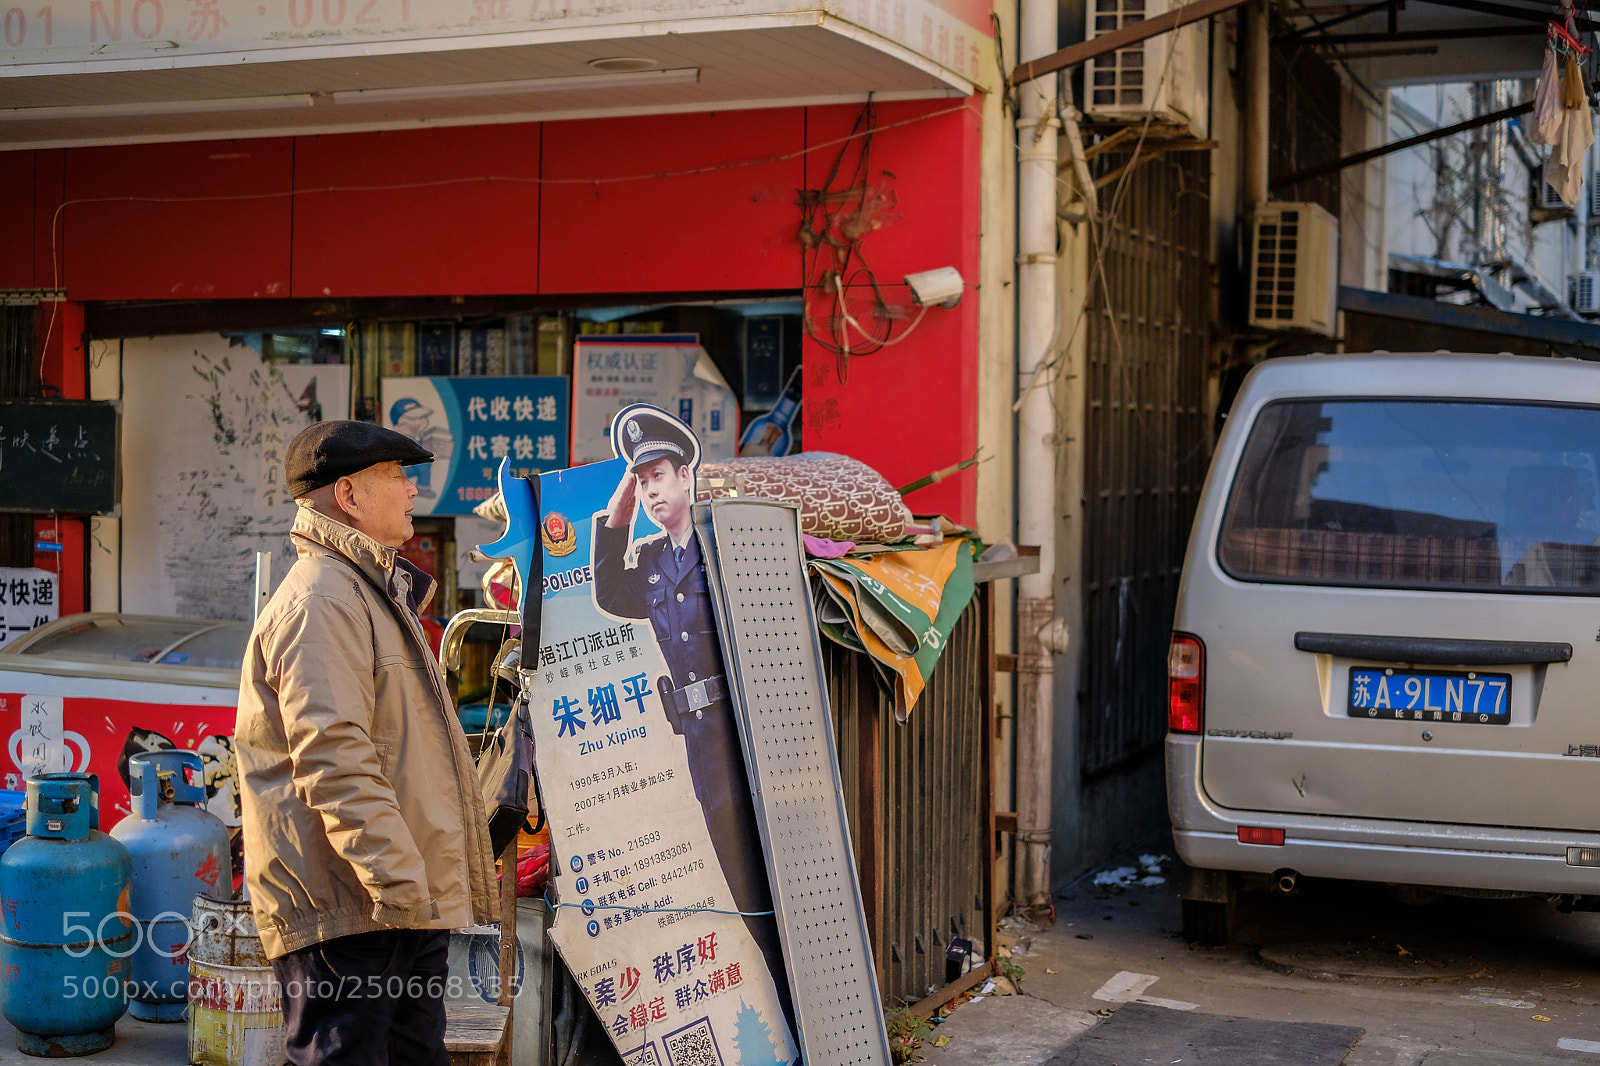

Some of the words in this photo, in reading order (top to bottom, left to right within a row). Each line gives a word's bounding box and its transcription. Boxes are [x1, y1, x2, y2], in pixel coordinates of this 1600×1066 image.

[467, 395, 557, 422] 代收快递
[467, 435, 557, 461] 代寄快递
[542, 566, 593, 594] POLICE
[552, 671, 653, 739] 朱细平
[578, 735, 604, 756] Zhu
[606, 726, 647, 749] Xiping
[574, 768, 675, 812] 2007年1月转业参加公安
[586, 848, 606, 866] 警号
[608, 846, 625, 859] No.
[627, 830, 661, 852] 215593
[592, 872, 613, 887] 手机
[612, 866, 632, 879] Tel:
[633, 841, 693, 872] 18913833081
[597, 883, 637, 907] 联系电话
[637, 878, 658, 893] Cell:
[660, 859, 705, 885] 84421476
[653, 894, 674, 911] Add:
[652, 931, 719, 985] 秩序好
[604, 996, 668, 1038] 会稳定
[674, 962, 744, 1010] 群众满意
